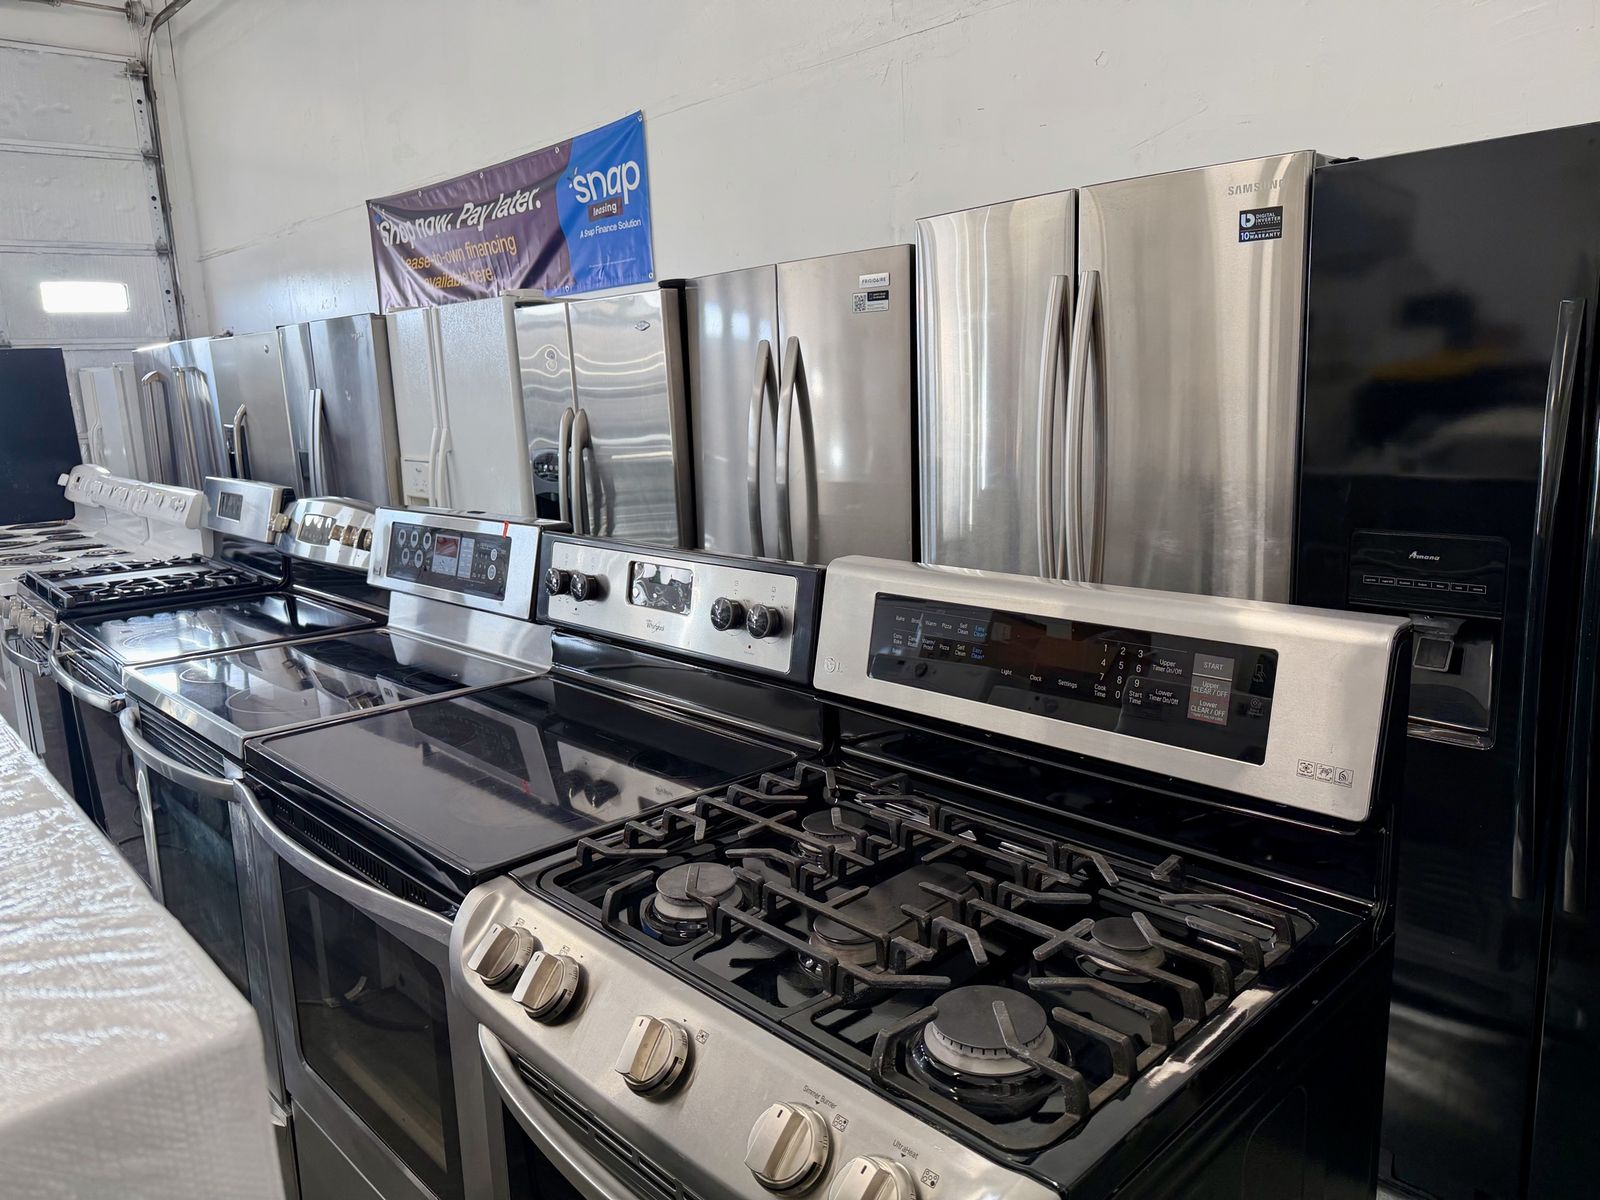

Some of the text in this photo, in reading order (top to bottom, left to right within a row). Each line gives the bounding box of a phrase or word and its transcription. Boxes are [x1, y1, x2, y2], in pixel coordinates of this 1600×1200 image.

[572, 160, 640, 205] snap
[593, 203, 617, 216] leasing
[380, 187, 542, 249] Shop now. Pay later.
[596, 224, 618, 234] Finance
[618, 218, 642, 230] Solution
[1240, 232, 1280, 240] 10 WARRANTY
[464, 235, 518, 257] financing
[1408, 550, 1441, 561] Amana
[1120, 646, 1126, 656] 2
[1138, 649, 1144, 658] 3
[1100, 658, 1142, 673] 4 5 6
[1160, 658, 1176, 667] Upper
[1203, 662, 1224, 670] START
[1000, 668, 1013, 676] Light
[1152, 664, 1182, 675] Timer On/Off
[1029, 674, 1042, 682] Clock
[1058, 679, 1078, 688] Settings
[1100, 672, 1140, 688] 7 8 9
[1094, 684, 1106, 692] Cook
[1202, 680, 1220, 690] Upper
[1094, 690, 1106, 698] Time
[1115, 690, 1121, 699] 0
[1128, 690, 1142, 698] Start
[1155, 688, 1173, 697] Lower
[1192, 686, 1212, 696] CLEAR
[1216, 690, 1228, 698] OFF
[1128, 697, 1142, 705] Time
[1149, 694, 1179, 705] Timer On/Off
[1200, 700, 1218, 708] Lower
[1190, 705, 1209, 714] CLEAR
[1214, 709, 1226, 717] OFF
[802, 1084, 838, 1109] Simmer Burner
[892, 1139, 919, 1160] UltraHeat
